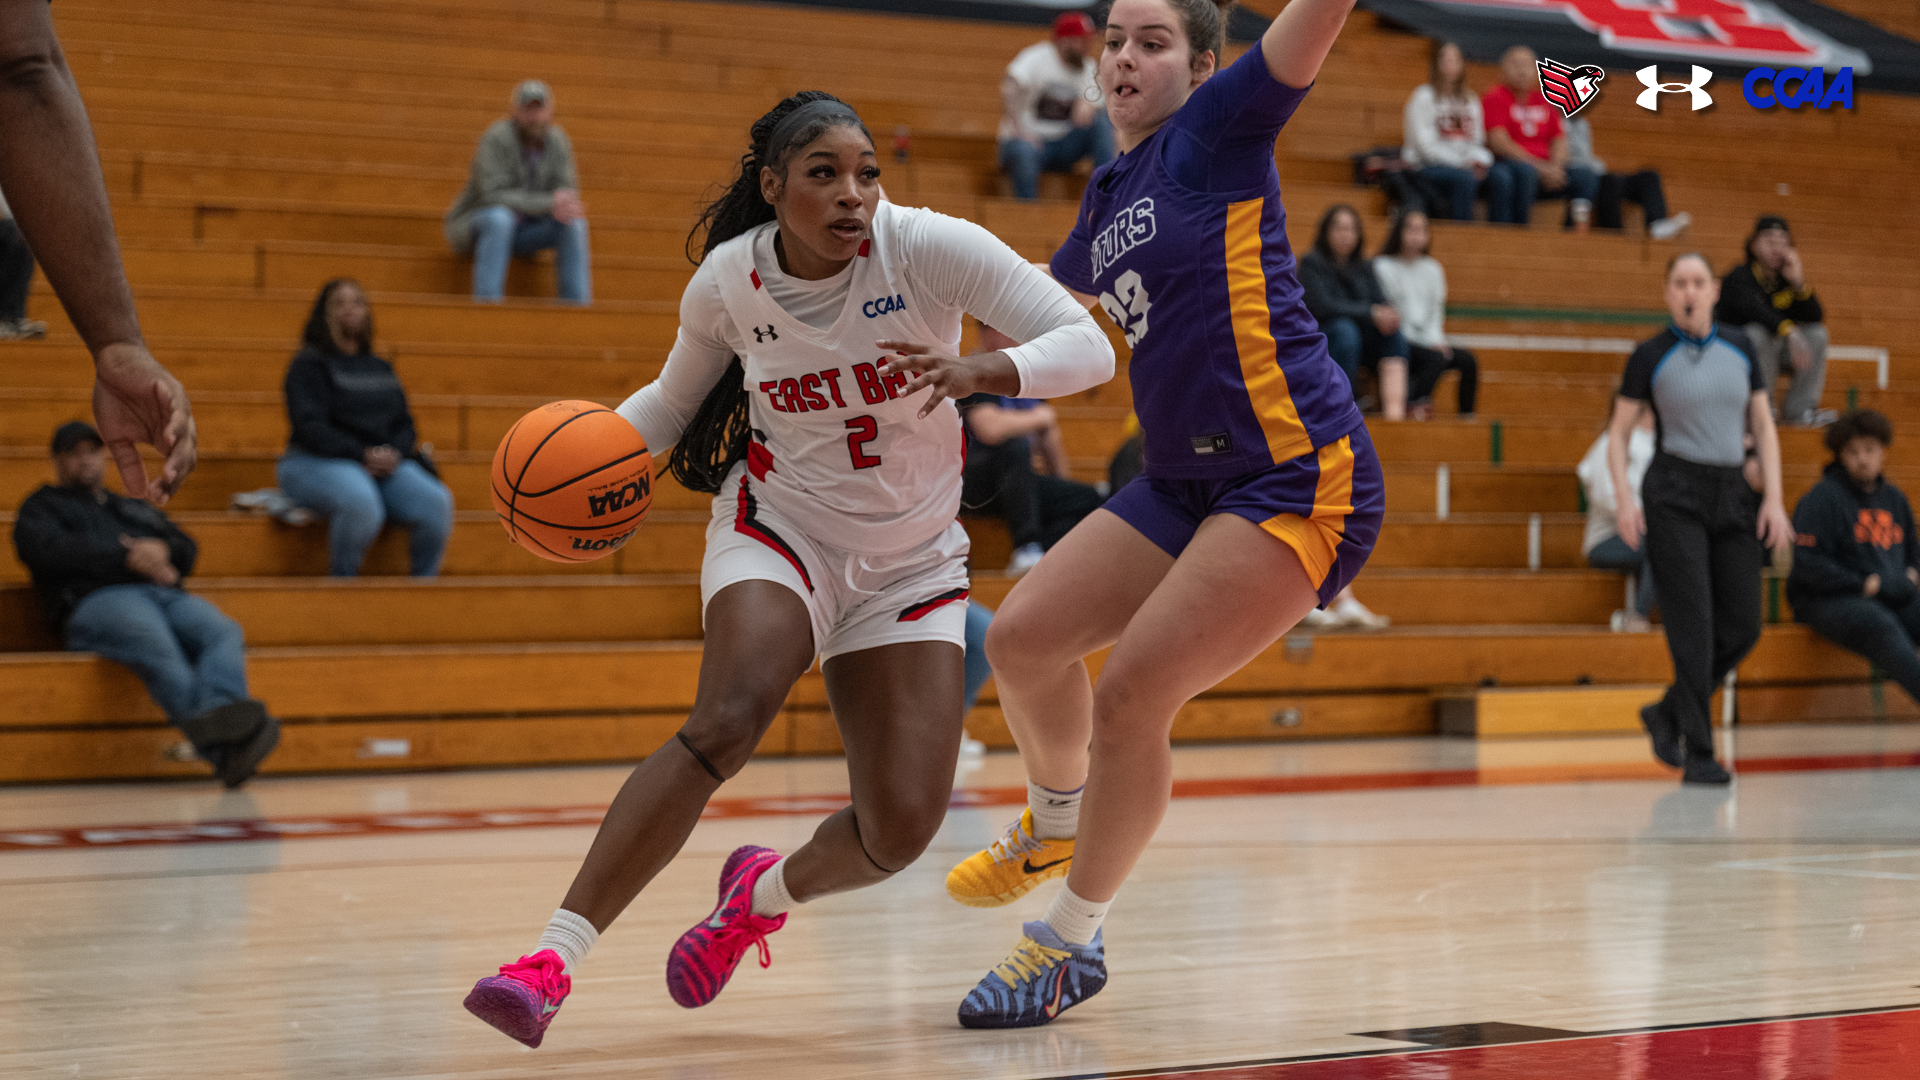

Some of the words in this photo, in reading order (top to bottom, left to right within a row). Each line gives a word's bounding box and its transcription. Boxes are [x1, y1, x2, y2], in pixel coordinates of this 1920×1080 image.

[862, 294, 906, 318] CCAA
[759, 368, 847, 413] EAST
[844, 415, 881, 470] 2
[1216, 438, 1226, 448] M
[588, 471, 650, 518] NCAA
